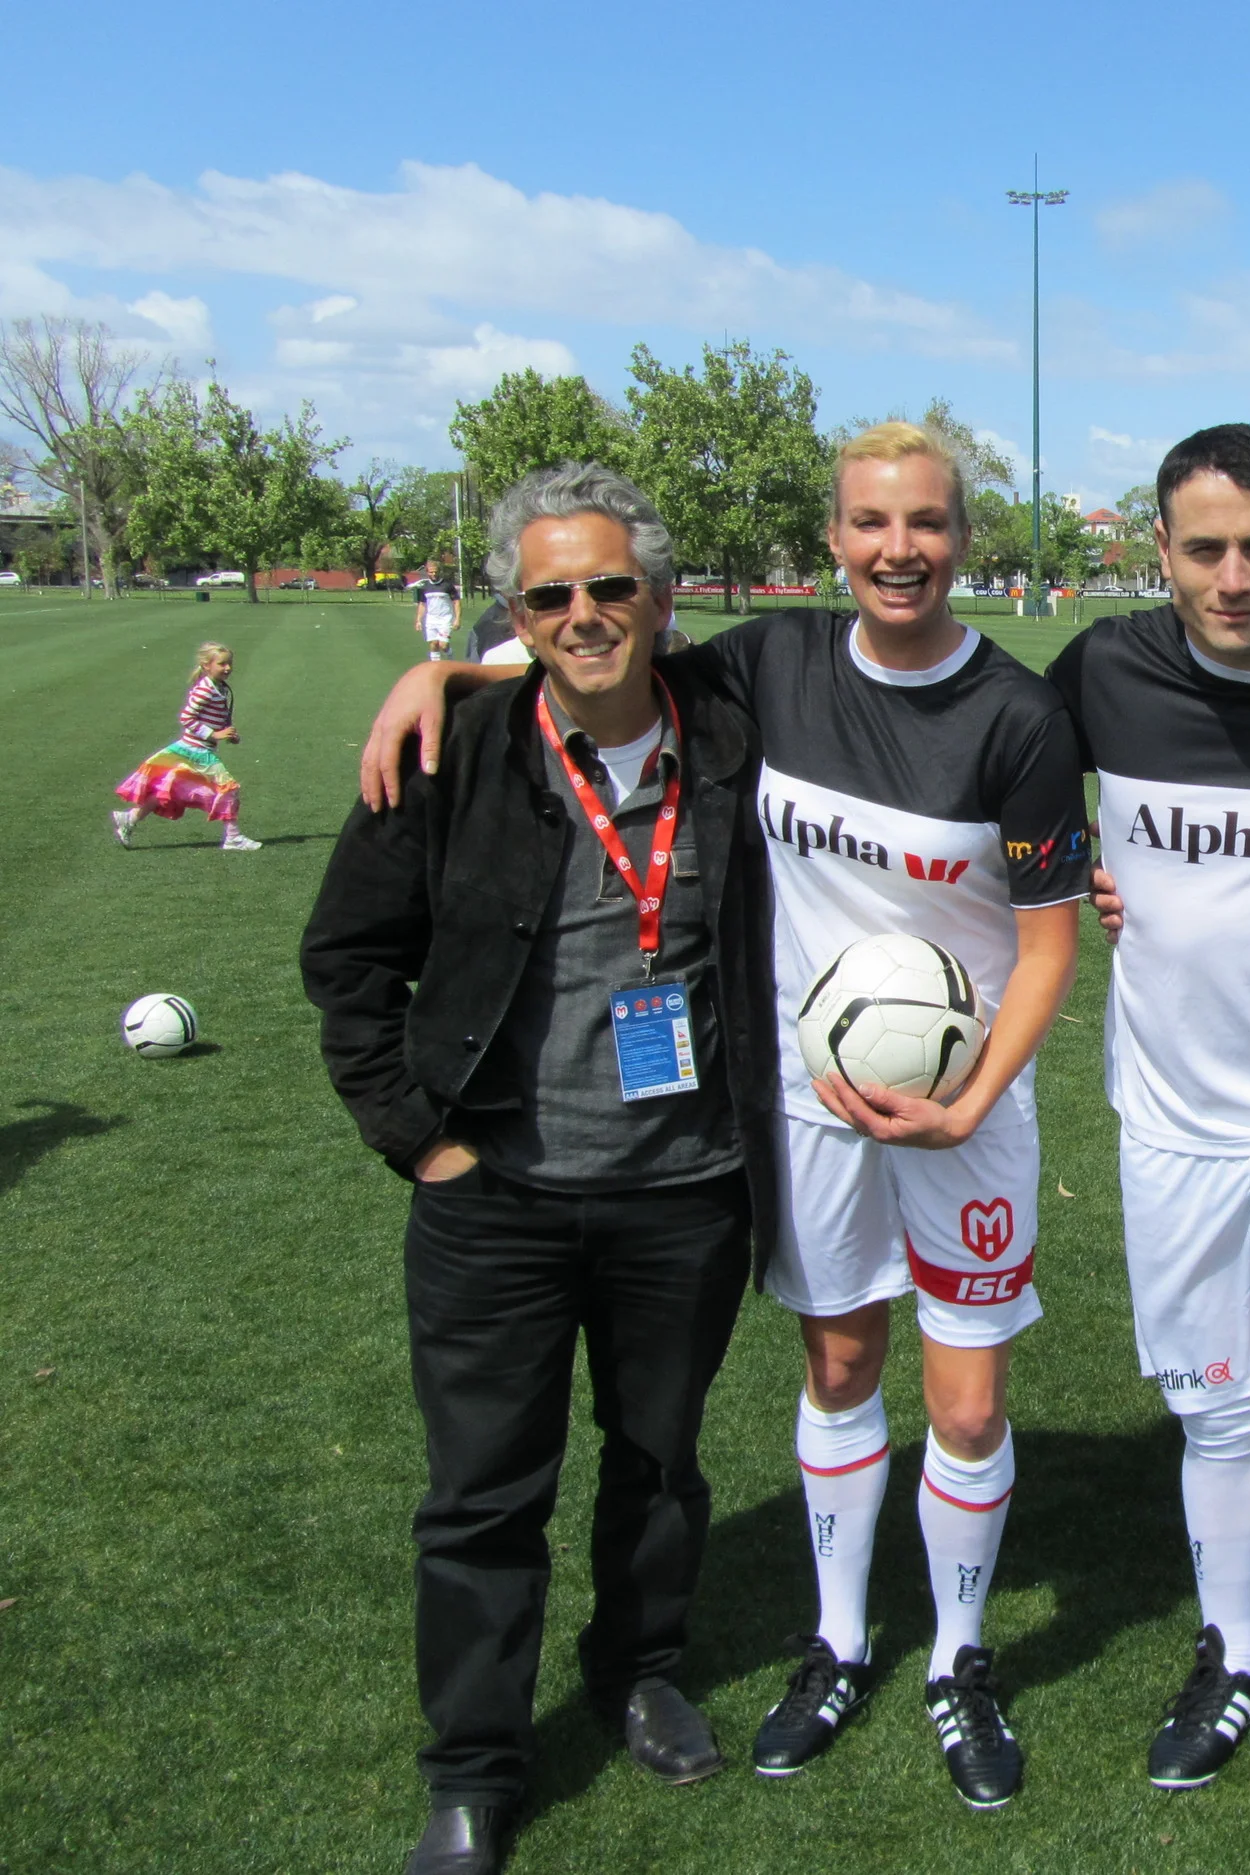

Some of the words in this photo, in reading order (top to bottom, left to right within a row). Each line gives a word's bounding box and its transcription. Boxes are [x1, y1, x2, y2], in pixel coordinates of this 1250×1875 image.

[759, 792, 892, 870] Alpha
[640, 1086, 665, 1097] ACCESS
[665, 1083, 676, 1093] ALL
[677, 1080, 697, 1090] AREAS
[956, 1271, 1017, 1301] ISC
